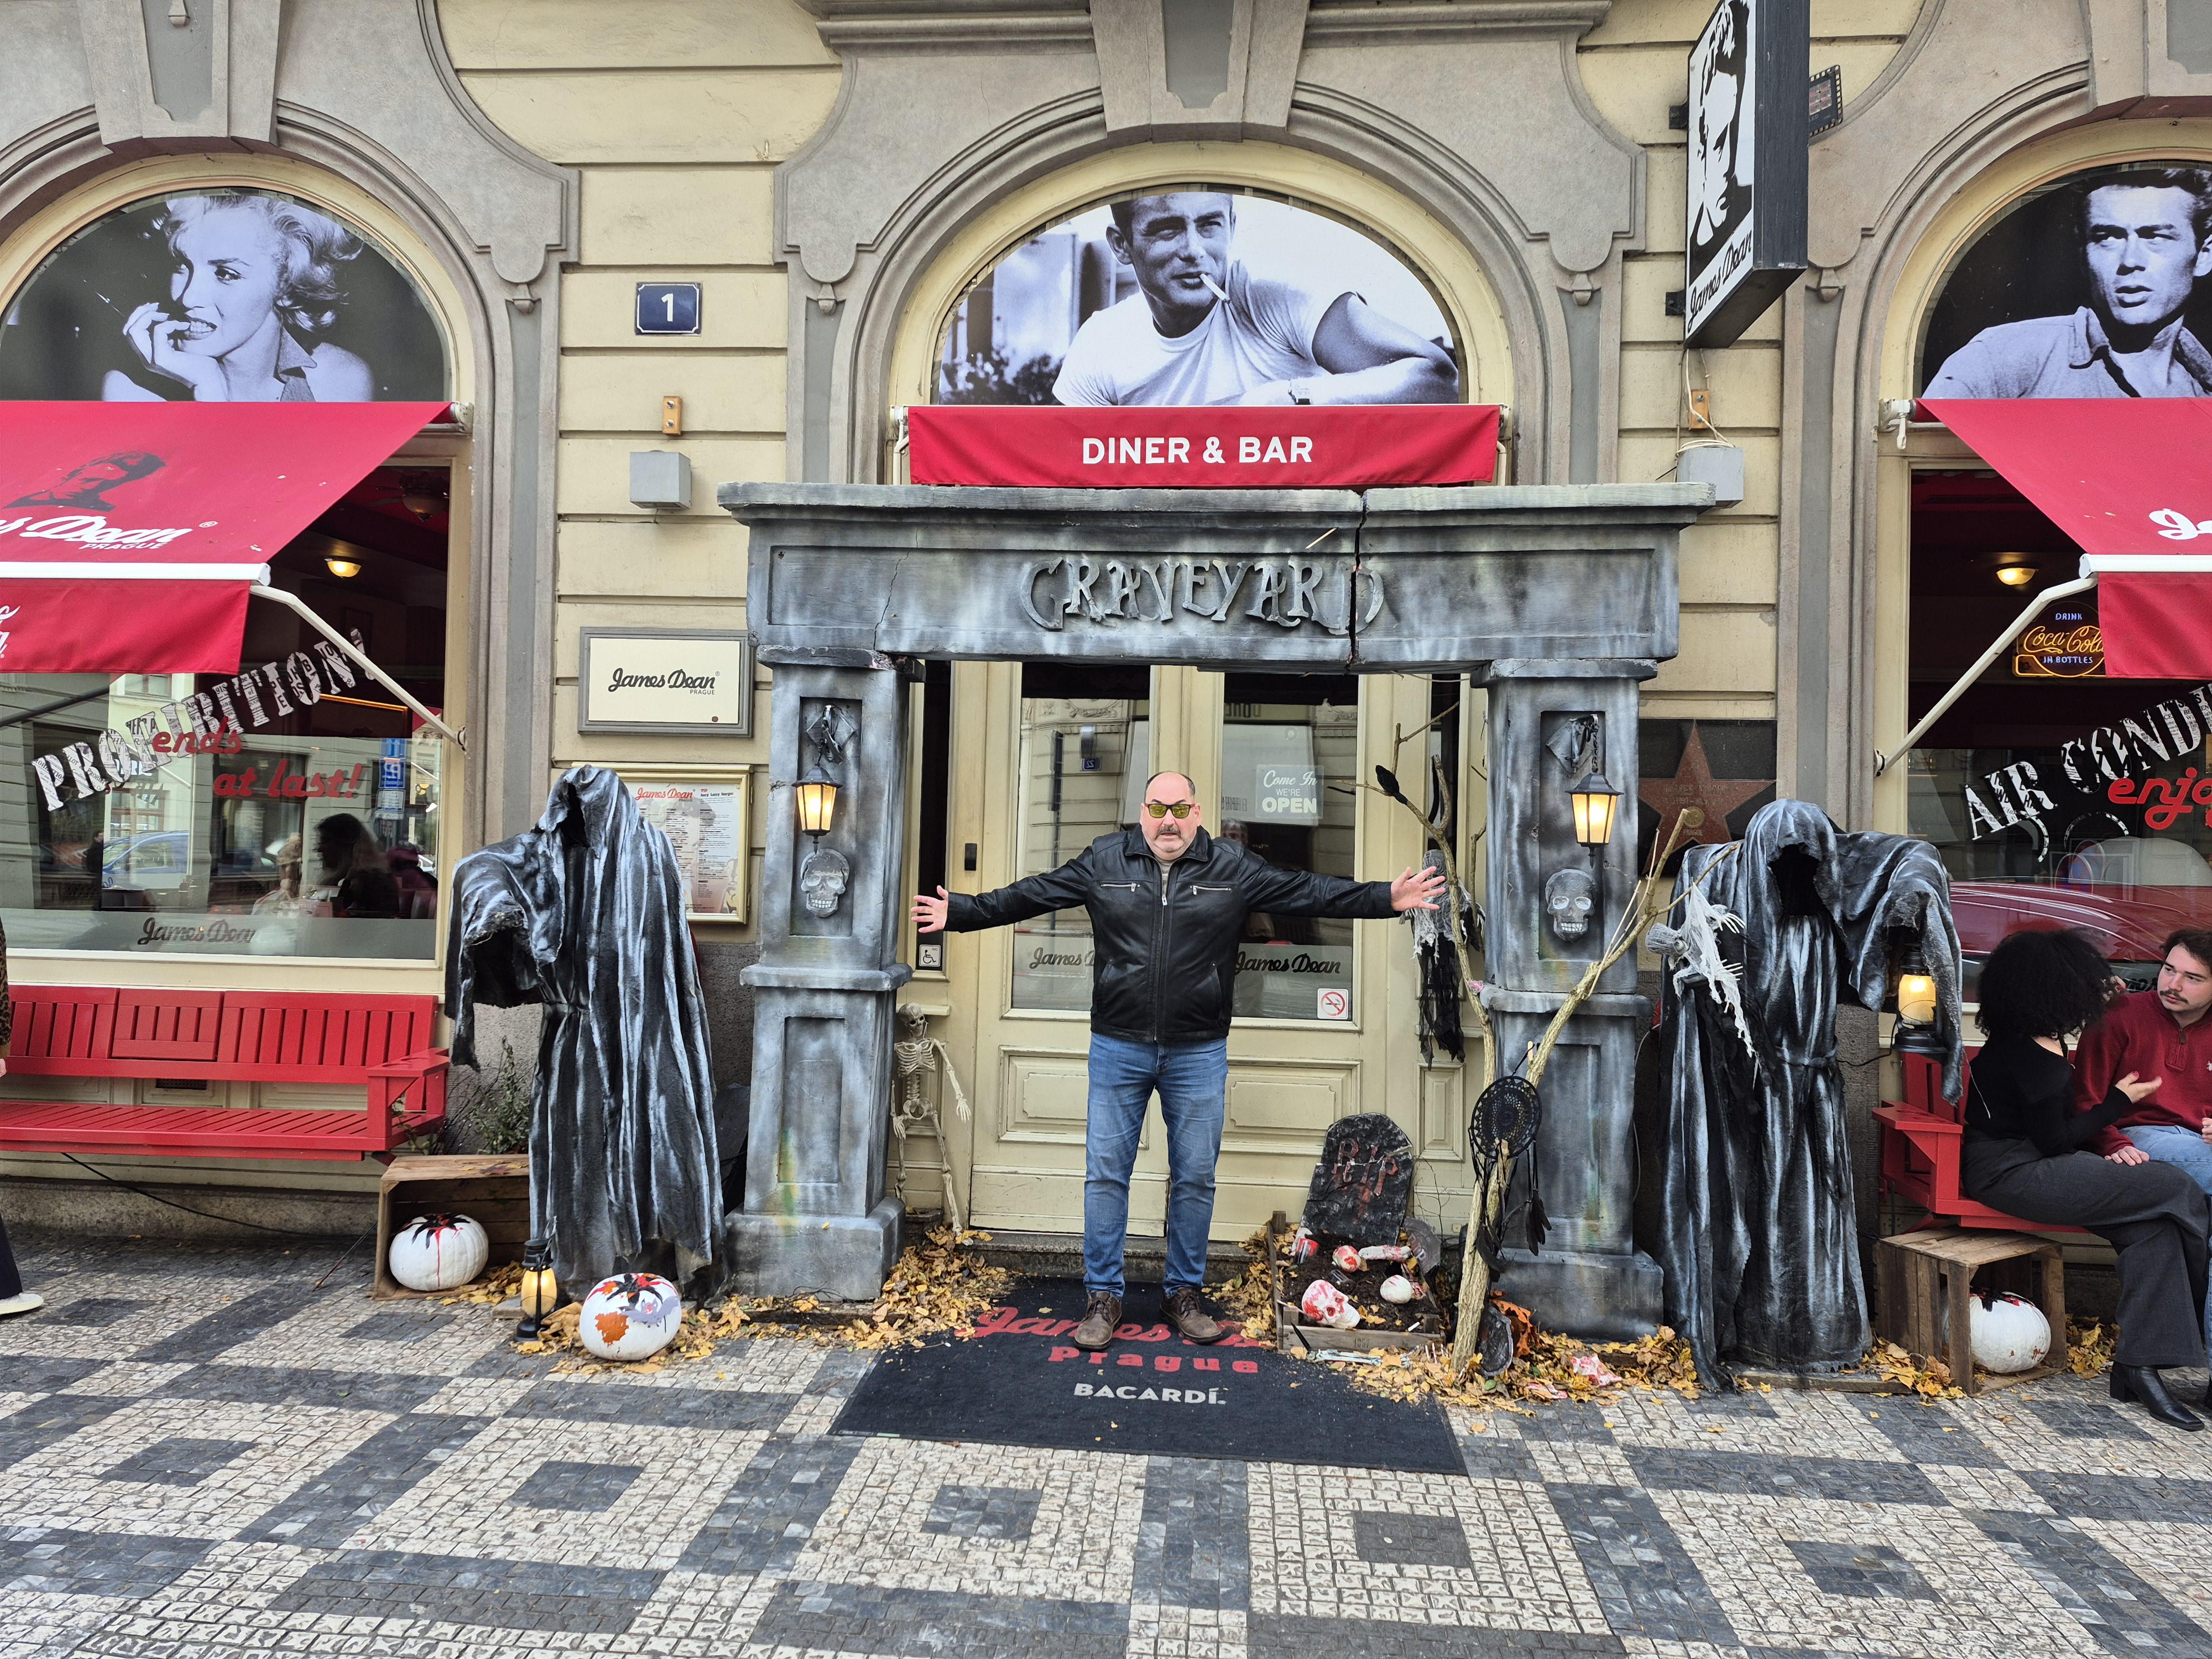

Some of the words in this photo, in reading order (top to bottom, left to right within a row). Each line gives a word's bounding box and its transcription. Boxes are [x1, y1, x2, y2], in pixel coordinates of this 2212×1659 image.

[1688, 266, 1721, 334] James
[1722, 229, 1752, 285] Dean
[661, 293, 674, 322] 1
[1082, 437, 1190, 464] DINER
[1202, 436, 1226, 463] &
[1239, 436, 1313, 463] BAR
[19, 515, 194, 544] Dean
[1019, 556, 1384, 635] GRAVEYARD
[608, 667, 666, 692] James
[667, 669, 716, 689] Dean
[152, 716, 242, 754] ends
[212, 767, 257, 797] at
[267, 758, 363, 799] last!
[1263, 770, 1296, 788] Come
[1300, 771, 1318, 786] In
[1276, 788, 1300, 796] WE'RE
[635, 787, 666, 801] James
[666, 787, 693, 799] Dean
[1262, 797, 1317, 813] OPEN
[1964, 761, 2059, 841] AIR
[137, 917, 205, 945] James
[1029, 947, 1082, 969] James
[1235, 951, 1290, 975] James
[1291, 952, 1341, 974] Dean
[1331, 1137, 1400, 1197] RIP
[1047, 1345, 1259, 1374] Prague
